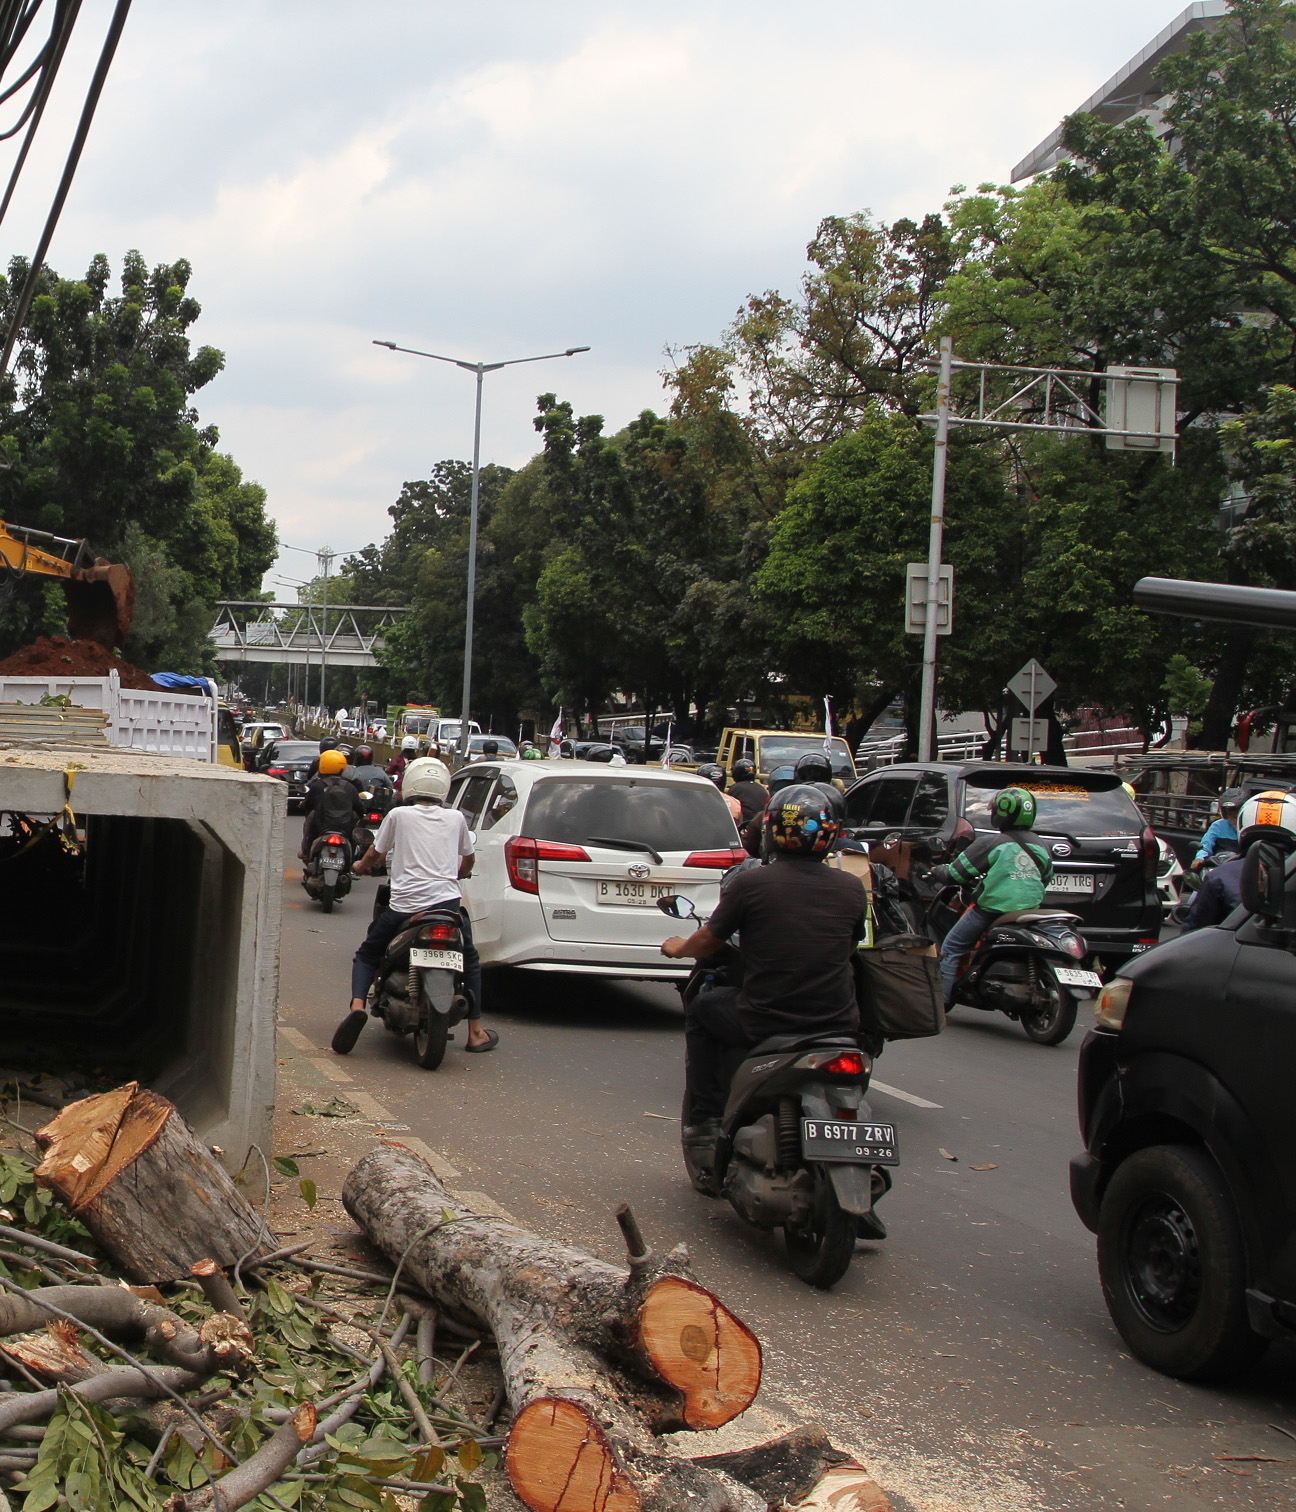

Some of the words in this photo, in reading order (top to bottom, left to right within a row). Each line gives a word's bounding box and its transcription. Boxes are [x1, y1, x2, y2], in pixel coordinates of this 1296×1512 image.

[601, 882, 609, 896] B
[615, 883, 645, 897] 1630
[650, 884, 673, 899] DKT
[423, 950, 444, 959] 3968
[808, 1123, 817, 1138] B
[824, 1125, 857, 1141] 6977
[864, 1126, 891, 1142] ZRV
